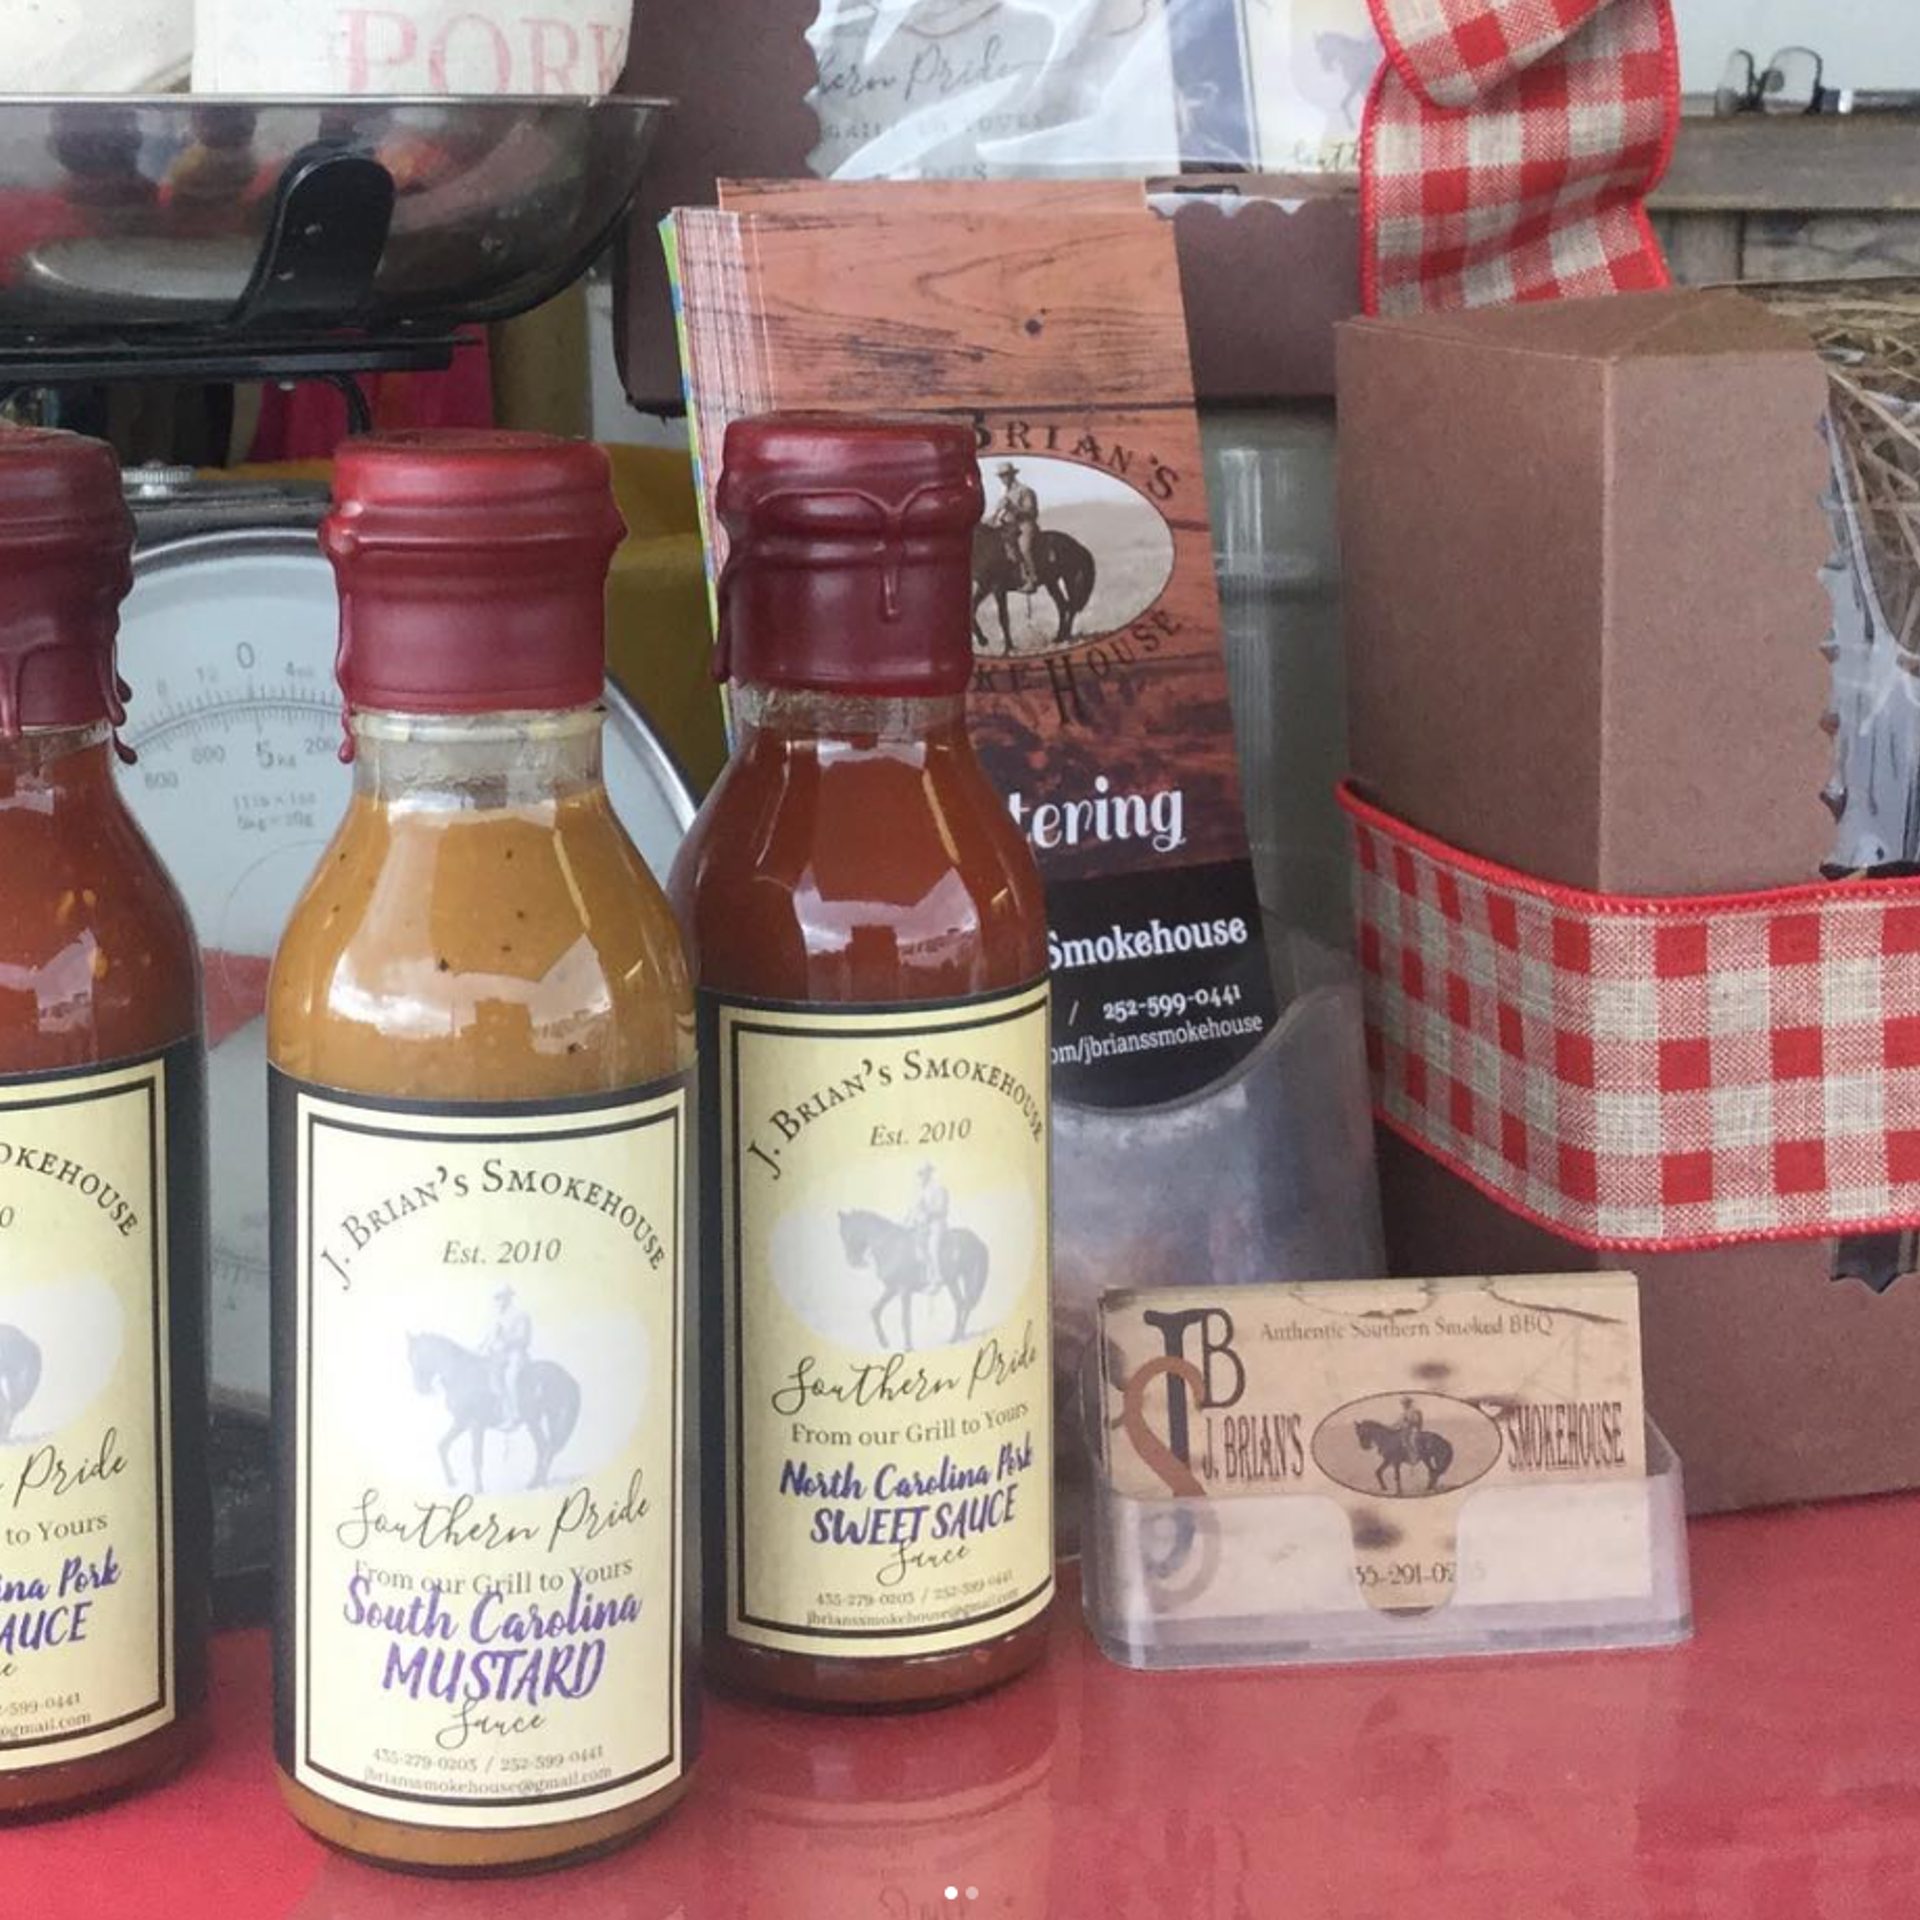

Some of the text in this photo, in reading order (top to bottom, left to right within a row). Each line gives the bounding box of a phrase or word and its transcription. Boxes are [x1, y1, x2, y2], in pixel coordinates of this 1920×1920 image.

[1048, 916, 1248, 970] Smokehouse
[1103, 984, 1241, 1023] 252-599-0441
[869, 1117, 972, 1148] Est. 2010
[747, 1138, 781, 1181] J.
[320, 1248, 352, 1291] J.
[442, 1238, 563, 1265] Est. 2010
[1260, 1315, 1555, 1341] Authentic Southern Smoked BBQ
[771, 1319, 1037, 1416] Southern Pride
[791, 1402, 1030, 1447] From our Grill to Yours
[1203, 1400, 1627, 1482] J. BRIAN'S SMOKEHOUSE
[12, 1426, 128, 1508] Pride
[779, 1458, 868, 1500] North
[873, 1454, 992, 1501] Carolina
[7, 1515, 108, 1546] to Yours
[336, 1467, 653, 1553] Southern Pride
[810, 1483, 1019, 1545] SWEET SAUCE
[58, 1545, 122, 1598] Pork
[538, 1571, 565, 1593] to
[343, 1570, 644, 1646] South Carolina
[381, 1637, 606, 1706] MUSTARD
